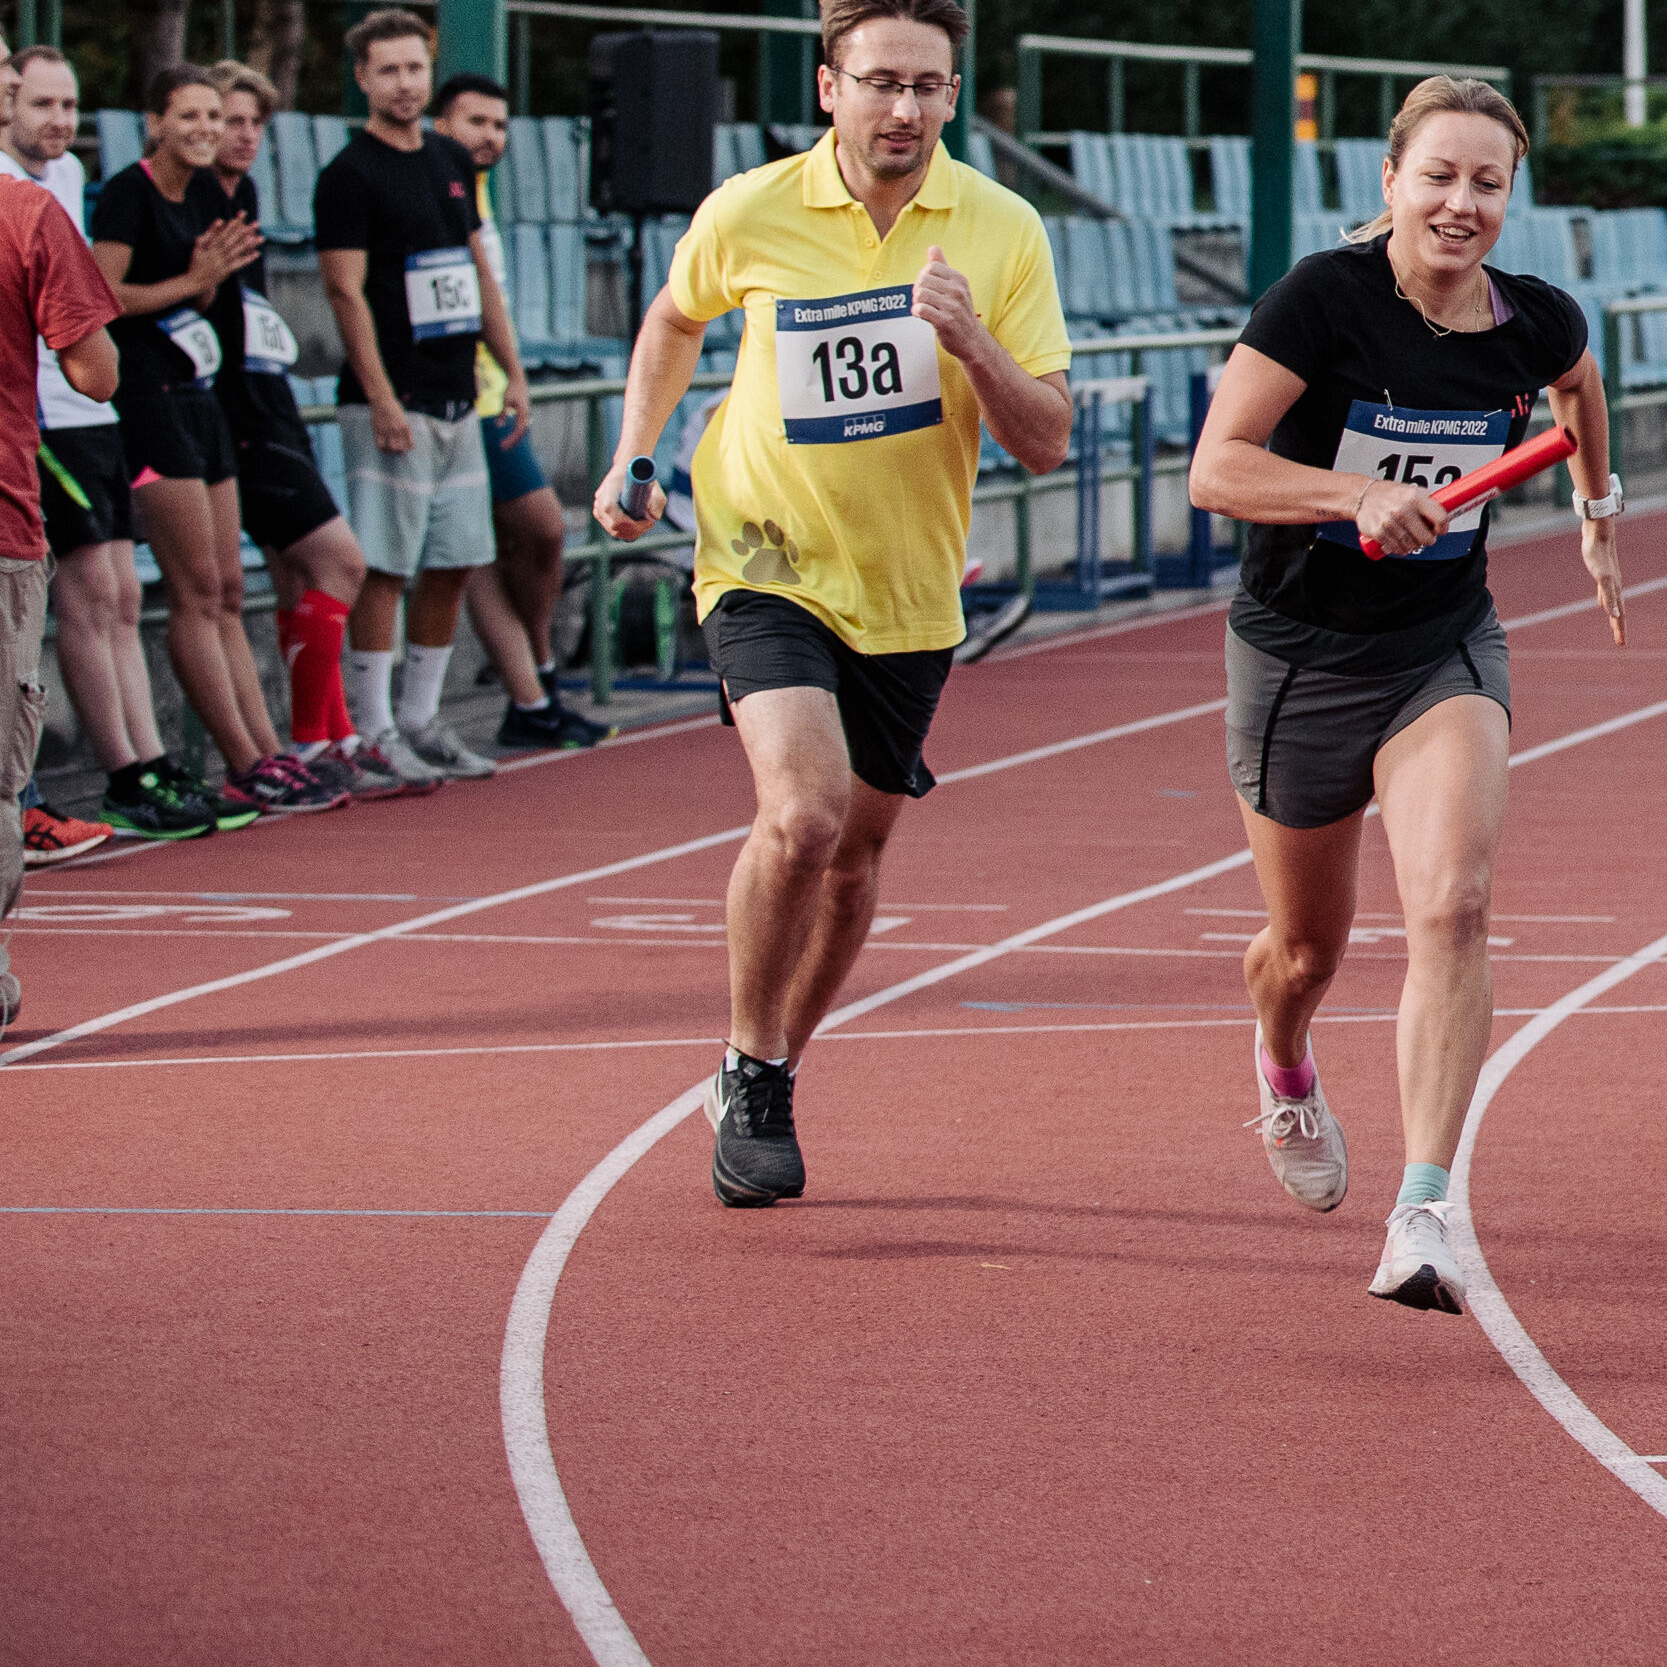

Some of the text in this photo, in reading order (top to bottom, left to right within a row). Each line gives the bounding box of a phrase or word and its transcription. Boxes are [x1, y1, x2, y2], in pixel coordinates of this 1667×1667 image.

[794, 293, 907, 324] Extra mile KPMG 2022
[811, 336, 904, 403] 13a
[843, 420, 885, 438] KPMG
[1373, 413, 1488, 437] Extra mile KPMG 2022
[1376, 452, 1462, 490] 15
